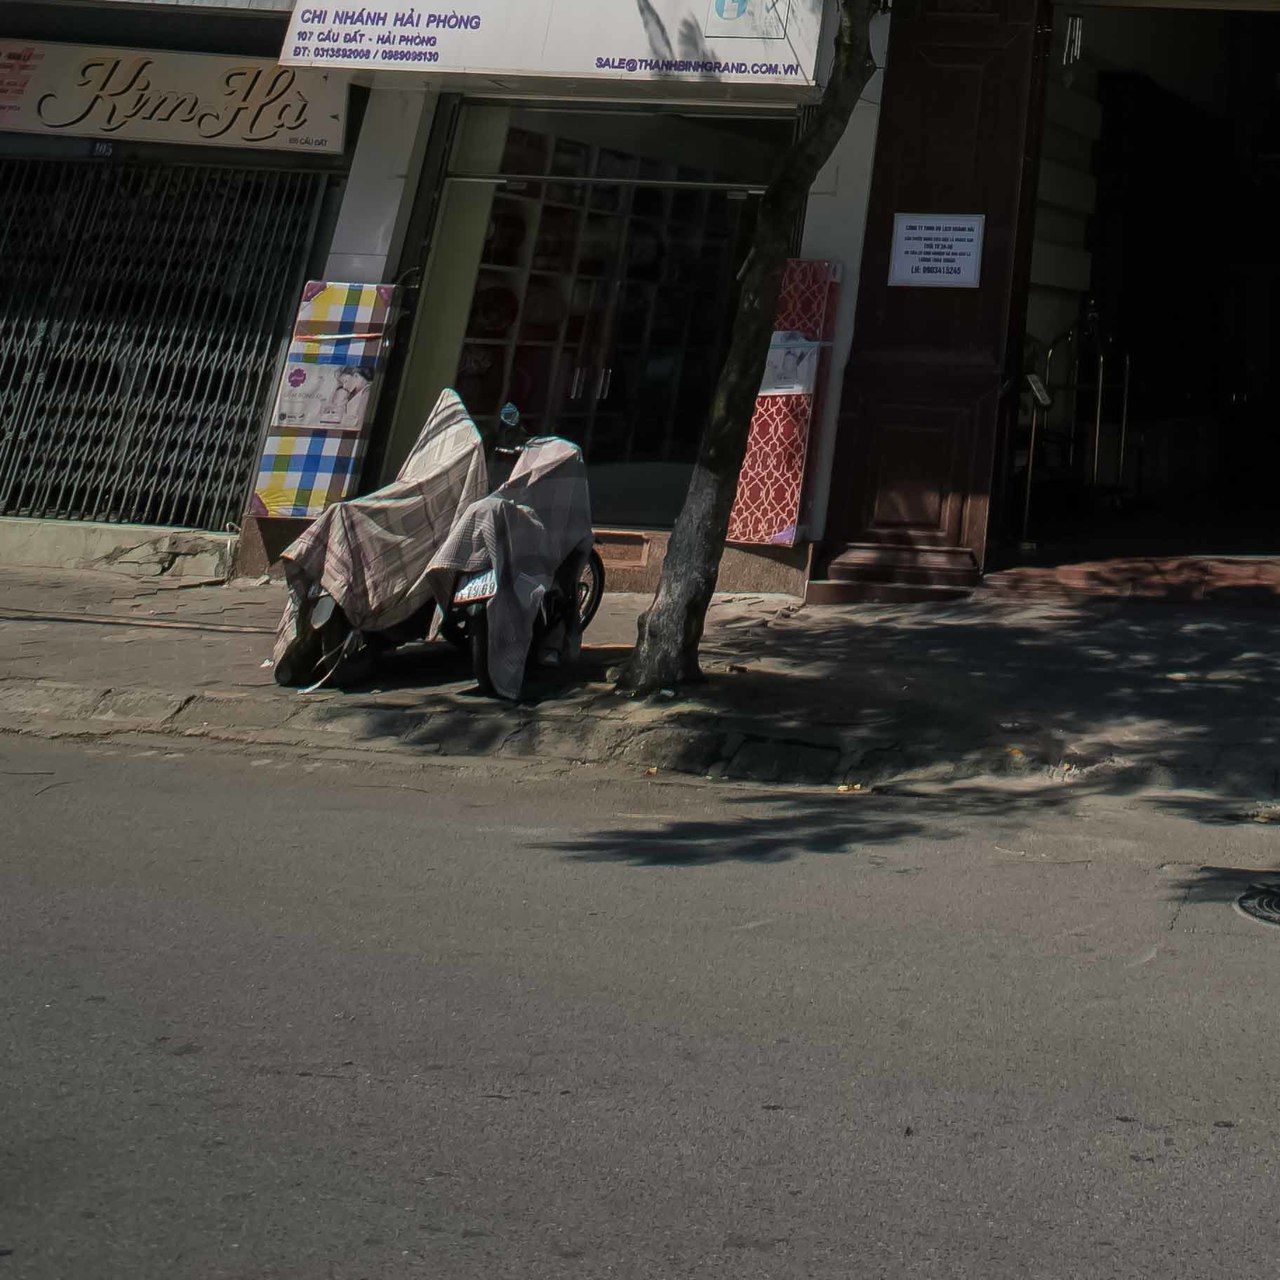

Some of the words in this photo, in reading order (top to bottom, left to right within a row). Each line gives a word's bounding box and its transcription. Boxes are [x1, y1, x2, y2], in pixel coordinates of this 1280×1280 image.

[301, 9, 328, 25] CHI
[332, 7, 388, 27] NHÁNH
[393, 8, 422, 28] HẢI
[426, 10, 481, 30] PHÒNG
[297, 30, 314, 42] 107
[398, 32, 437, 47] PHÒNG
[595, 57, 800, 76] SALE@THANHBINHGRAND.COM.VN
